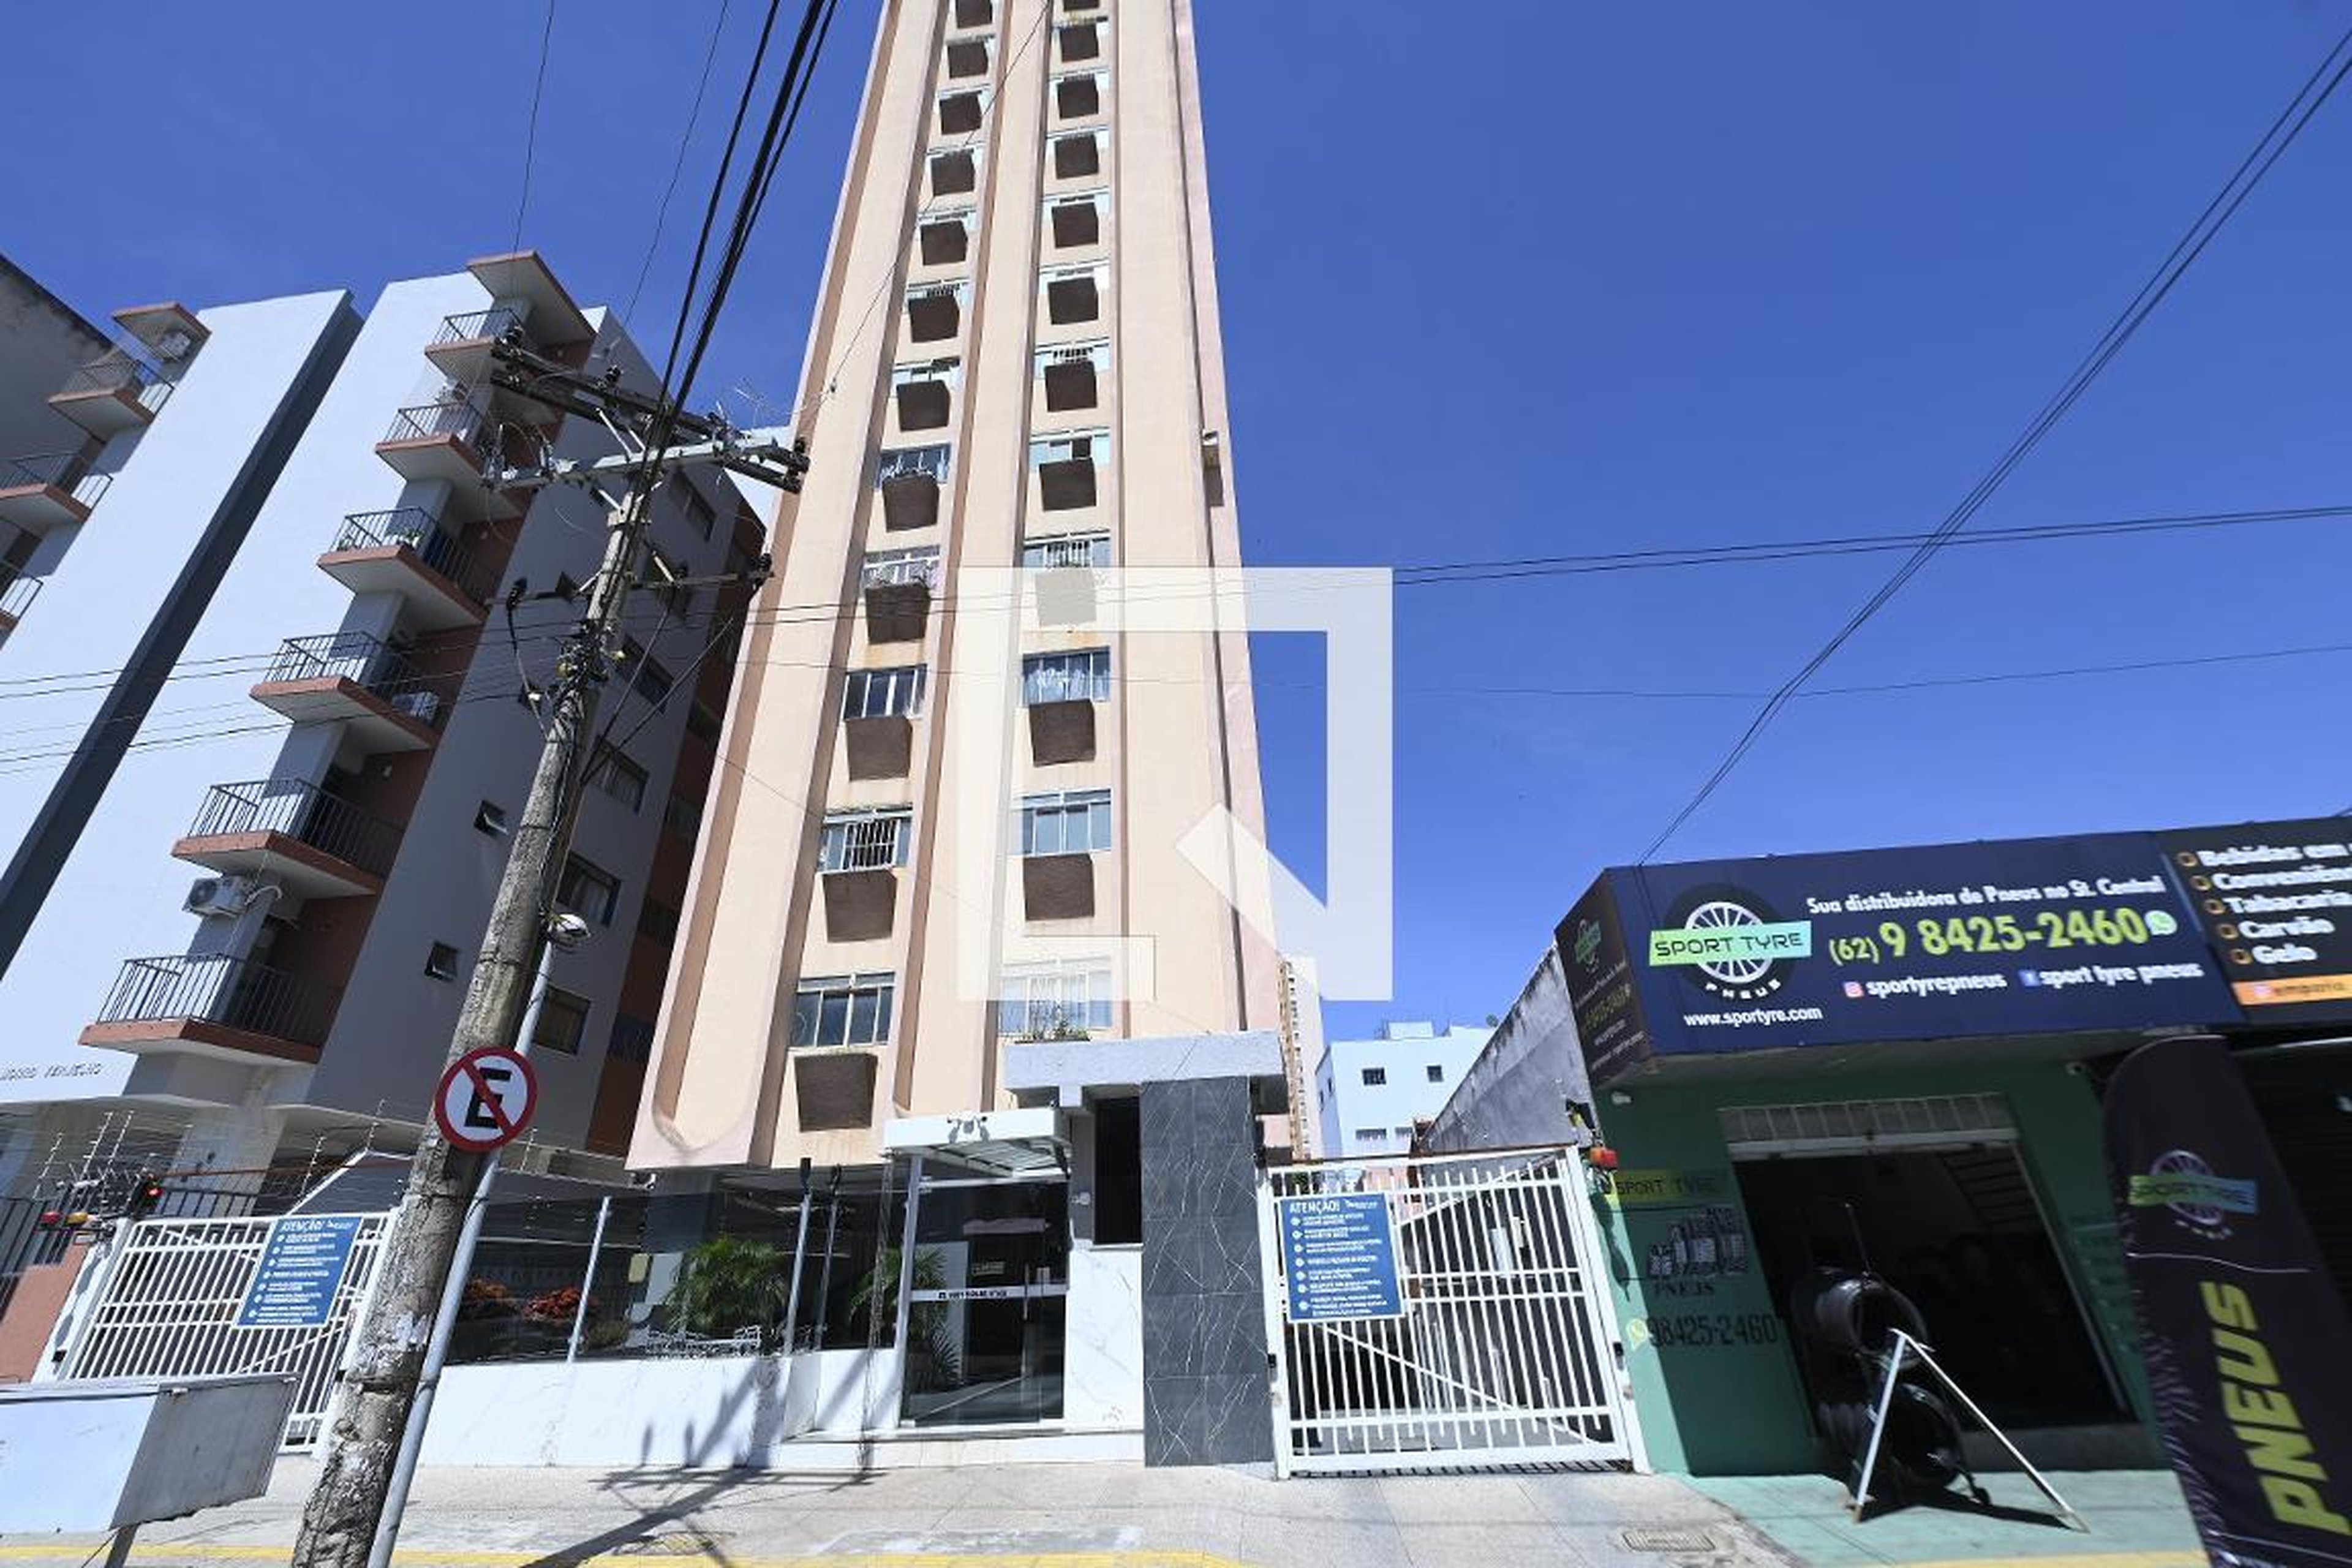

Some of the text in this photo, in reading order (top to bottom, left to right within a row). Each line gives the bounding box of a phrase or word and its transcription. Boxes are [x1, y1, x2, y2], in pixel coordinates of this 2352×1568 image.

[1807, 897, 1842, 914] Sua
[1845, 890, 1957, 911] distribuidora
[1959, 888, 1985, 905] de
[1983, 885, 2042, 903] Pneus
[1655, 932, 1804, 957] SPORT TYRE
[1829, 908, 2149, 967] (62) 9 8425-2460
[2252, 943, 2318, 964] Gelo
[1705, 979, 1781, 1000] PNEUS
[1684, 1008, 1823, 1027] www.sportyre.com
[1289, 1200, 1341, 1215] ATENÇÃO!
[2200, 1281, 2352, 1535] PNEUS
